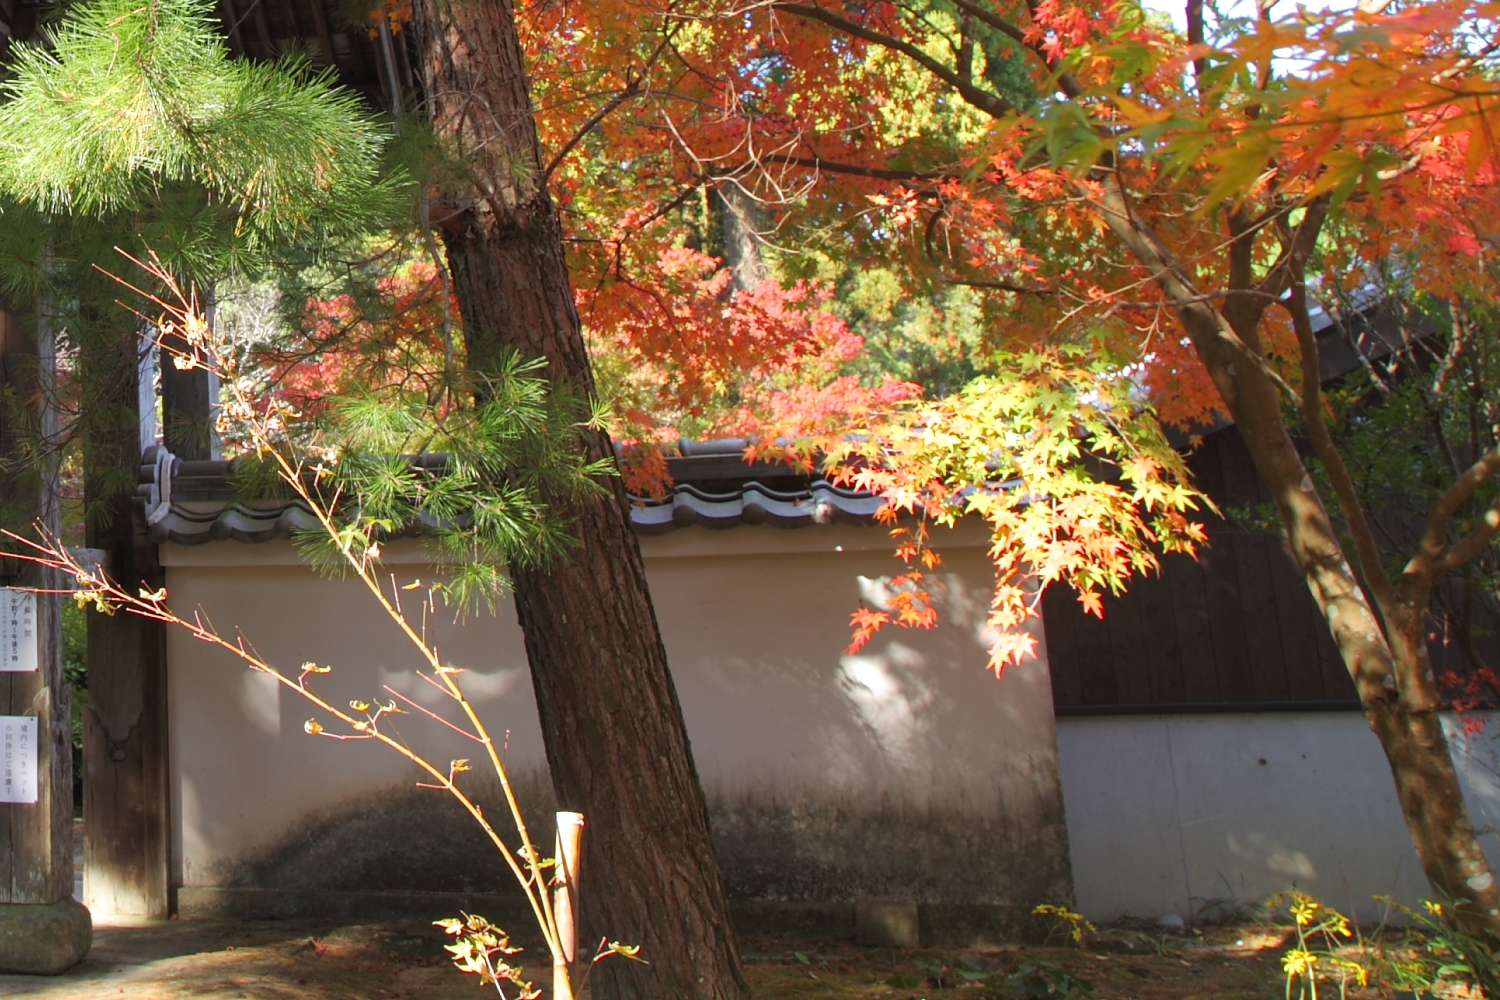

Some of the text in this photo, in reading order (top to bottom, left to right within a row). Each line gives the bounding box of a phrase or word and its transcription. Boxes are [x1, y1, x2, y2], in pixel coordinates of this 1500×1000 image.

[20, 724, 28, 795] 境内につきペット
